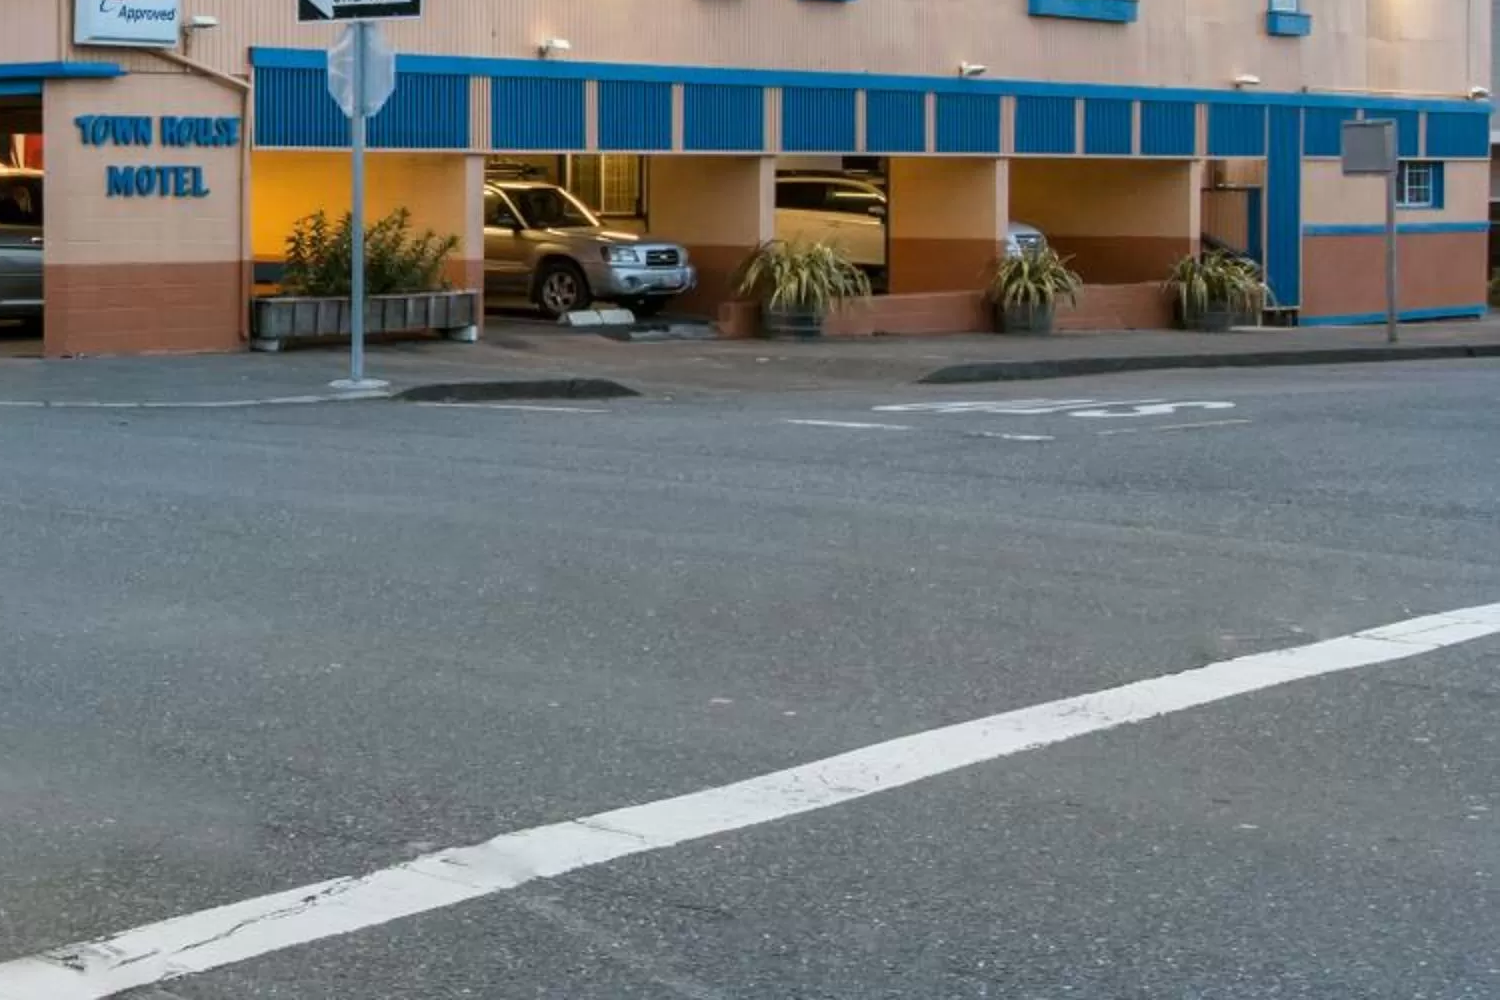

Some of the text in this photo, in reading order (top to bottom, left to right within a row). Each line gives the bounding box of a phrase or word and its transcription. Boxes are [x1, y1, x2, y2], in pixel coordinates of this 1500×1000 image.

[118, 4, 176, 22] Approved
[74, 114, 242, 147] TOWN HOUSE
[106, 165, 210, 197] MOTEL
